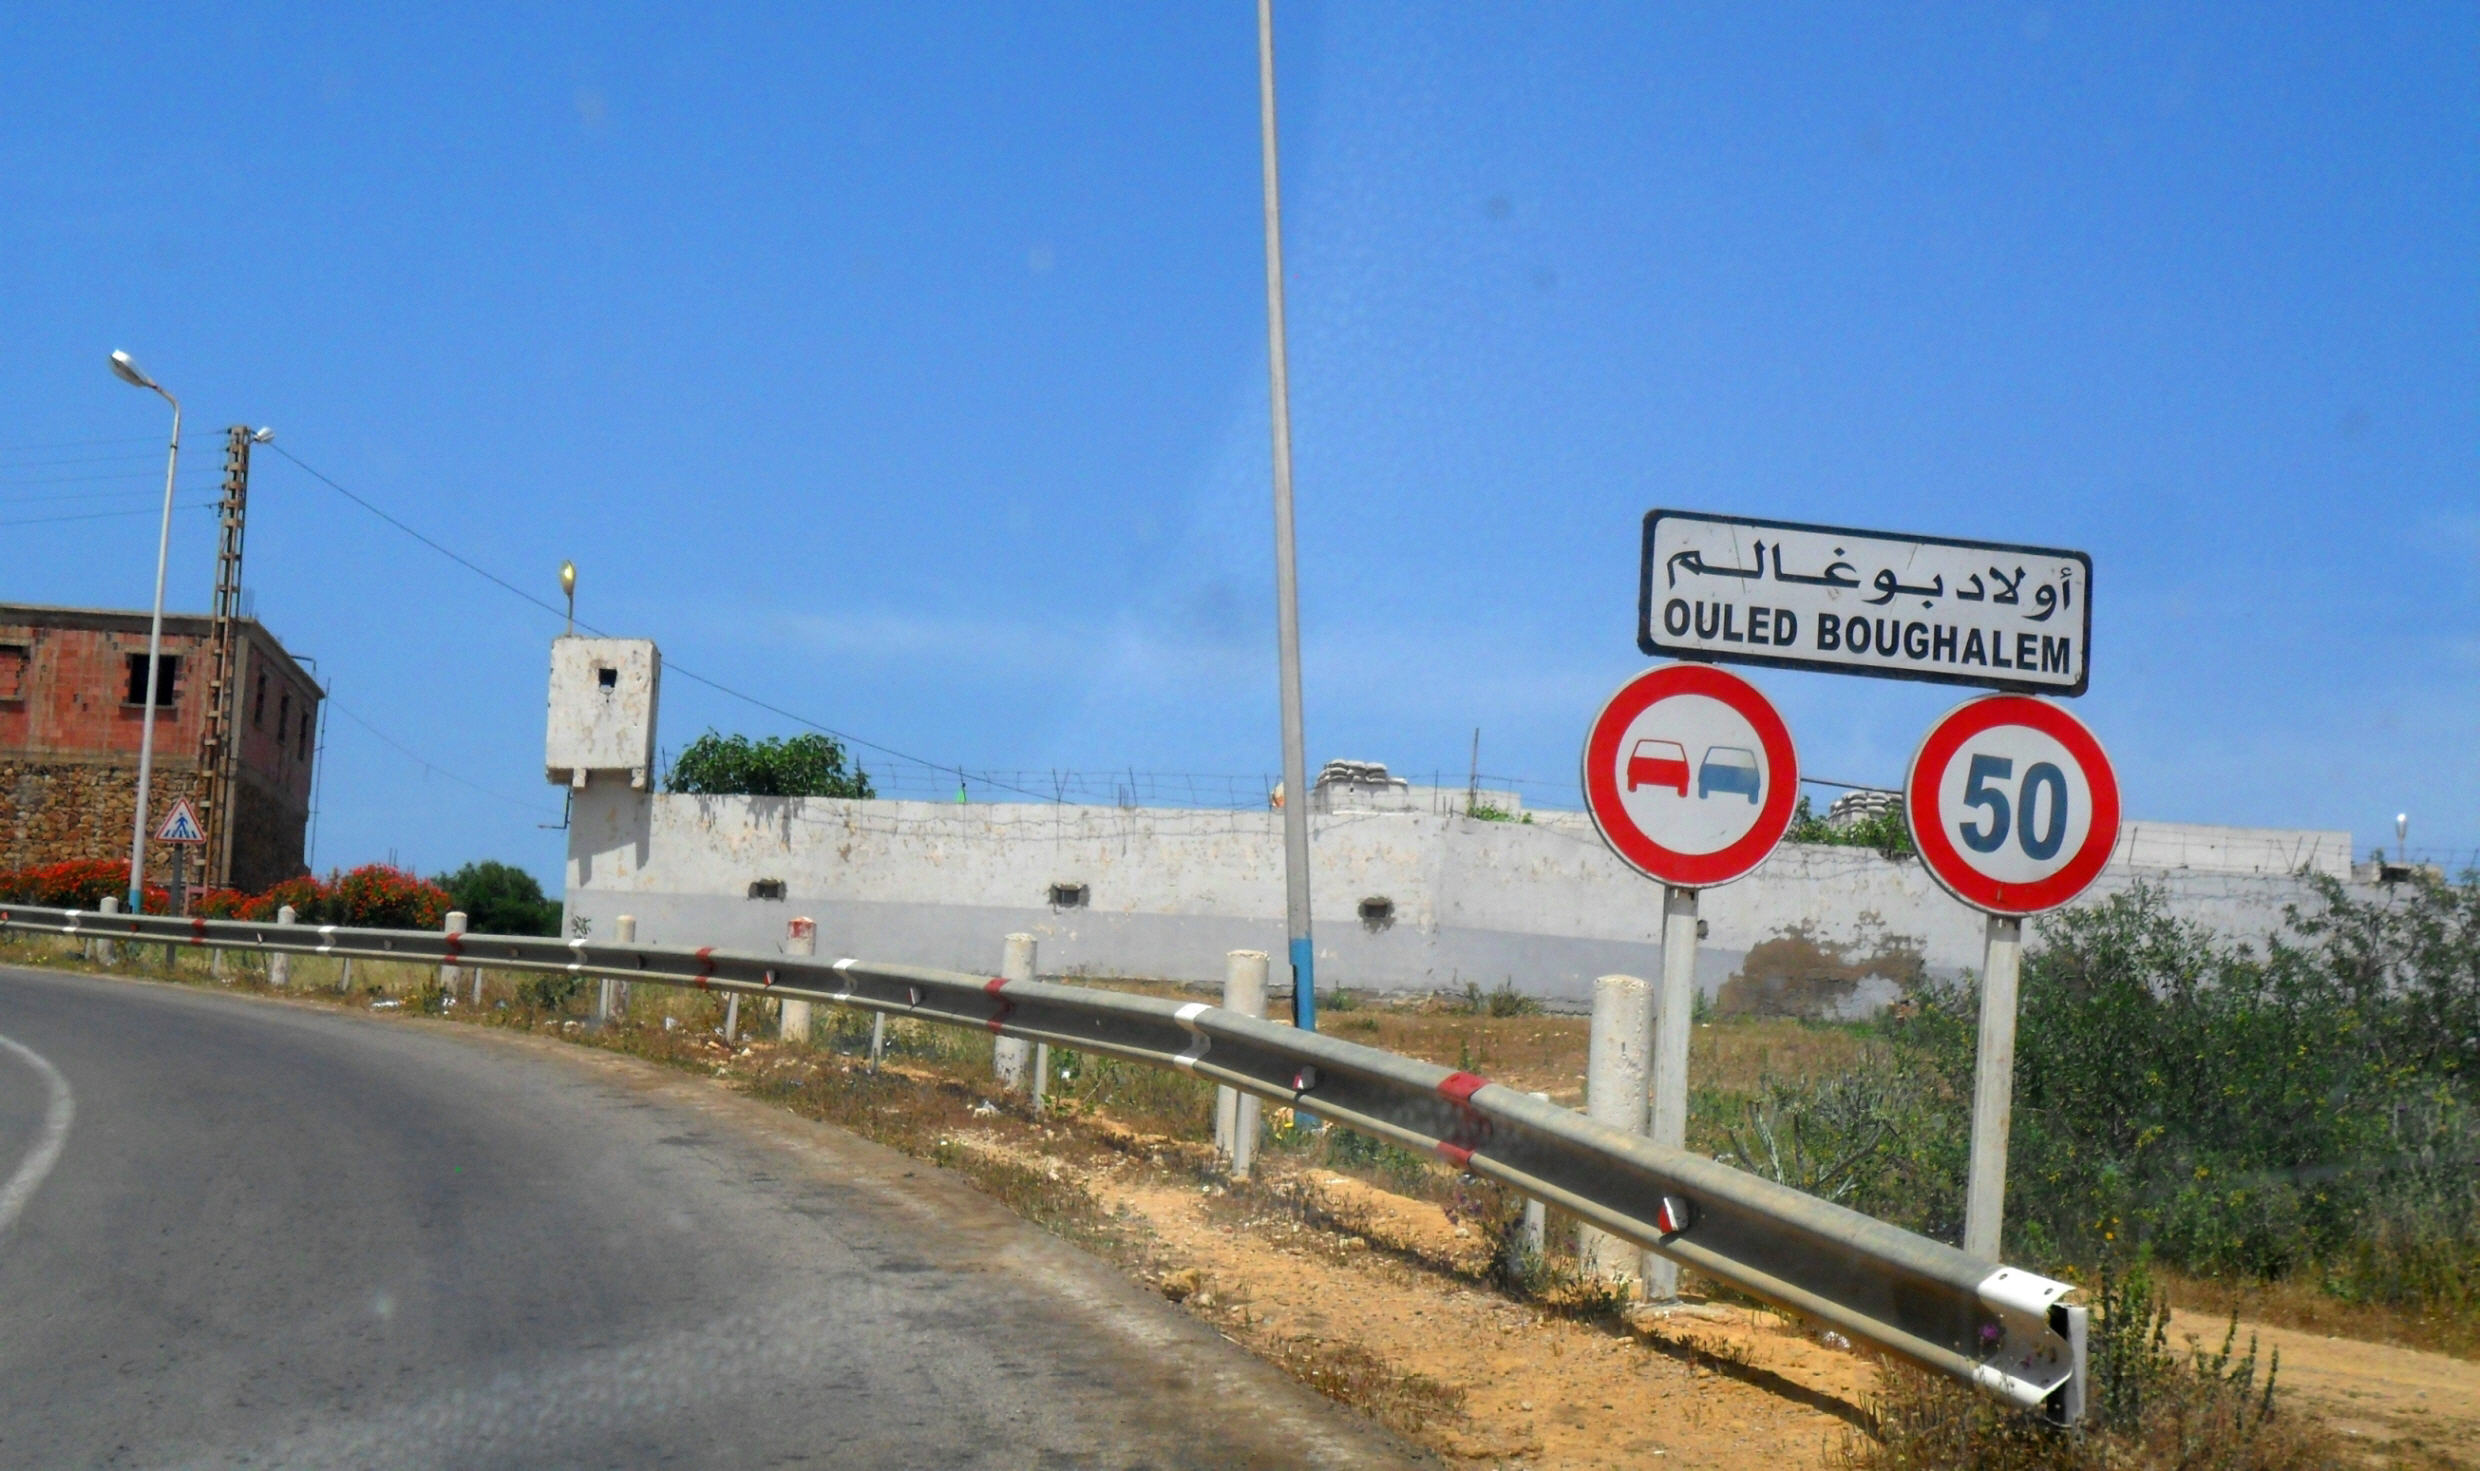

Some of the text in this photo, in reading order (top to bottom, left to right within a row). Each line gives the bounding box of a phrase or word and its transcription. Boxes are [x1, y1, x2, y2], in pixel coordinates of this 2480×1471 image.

[1663, 597, 2071, 675] OULED BOUGHALEM
[1959, 753, 2068, 861] 50
